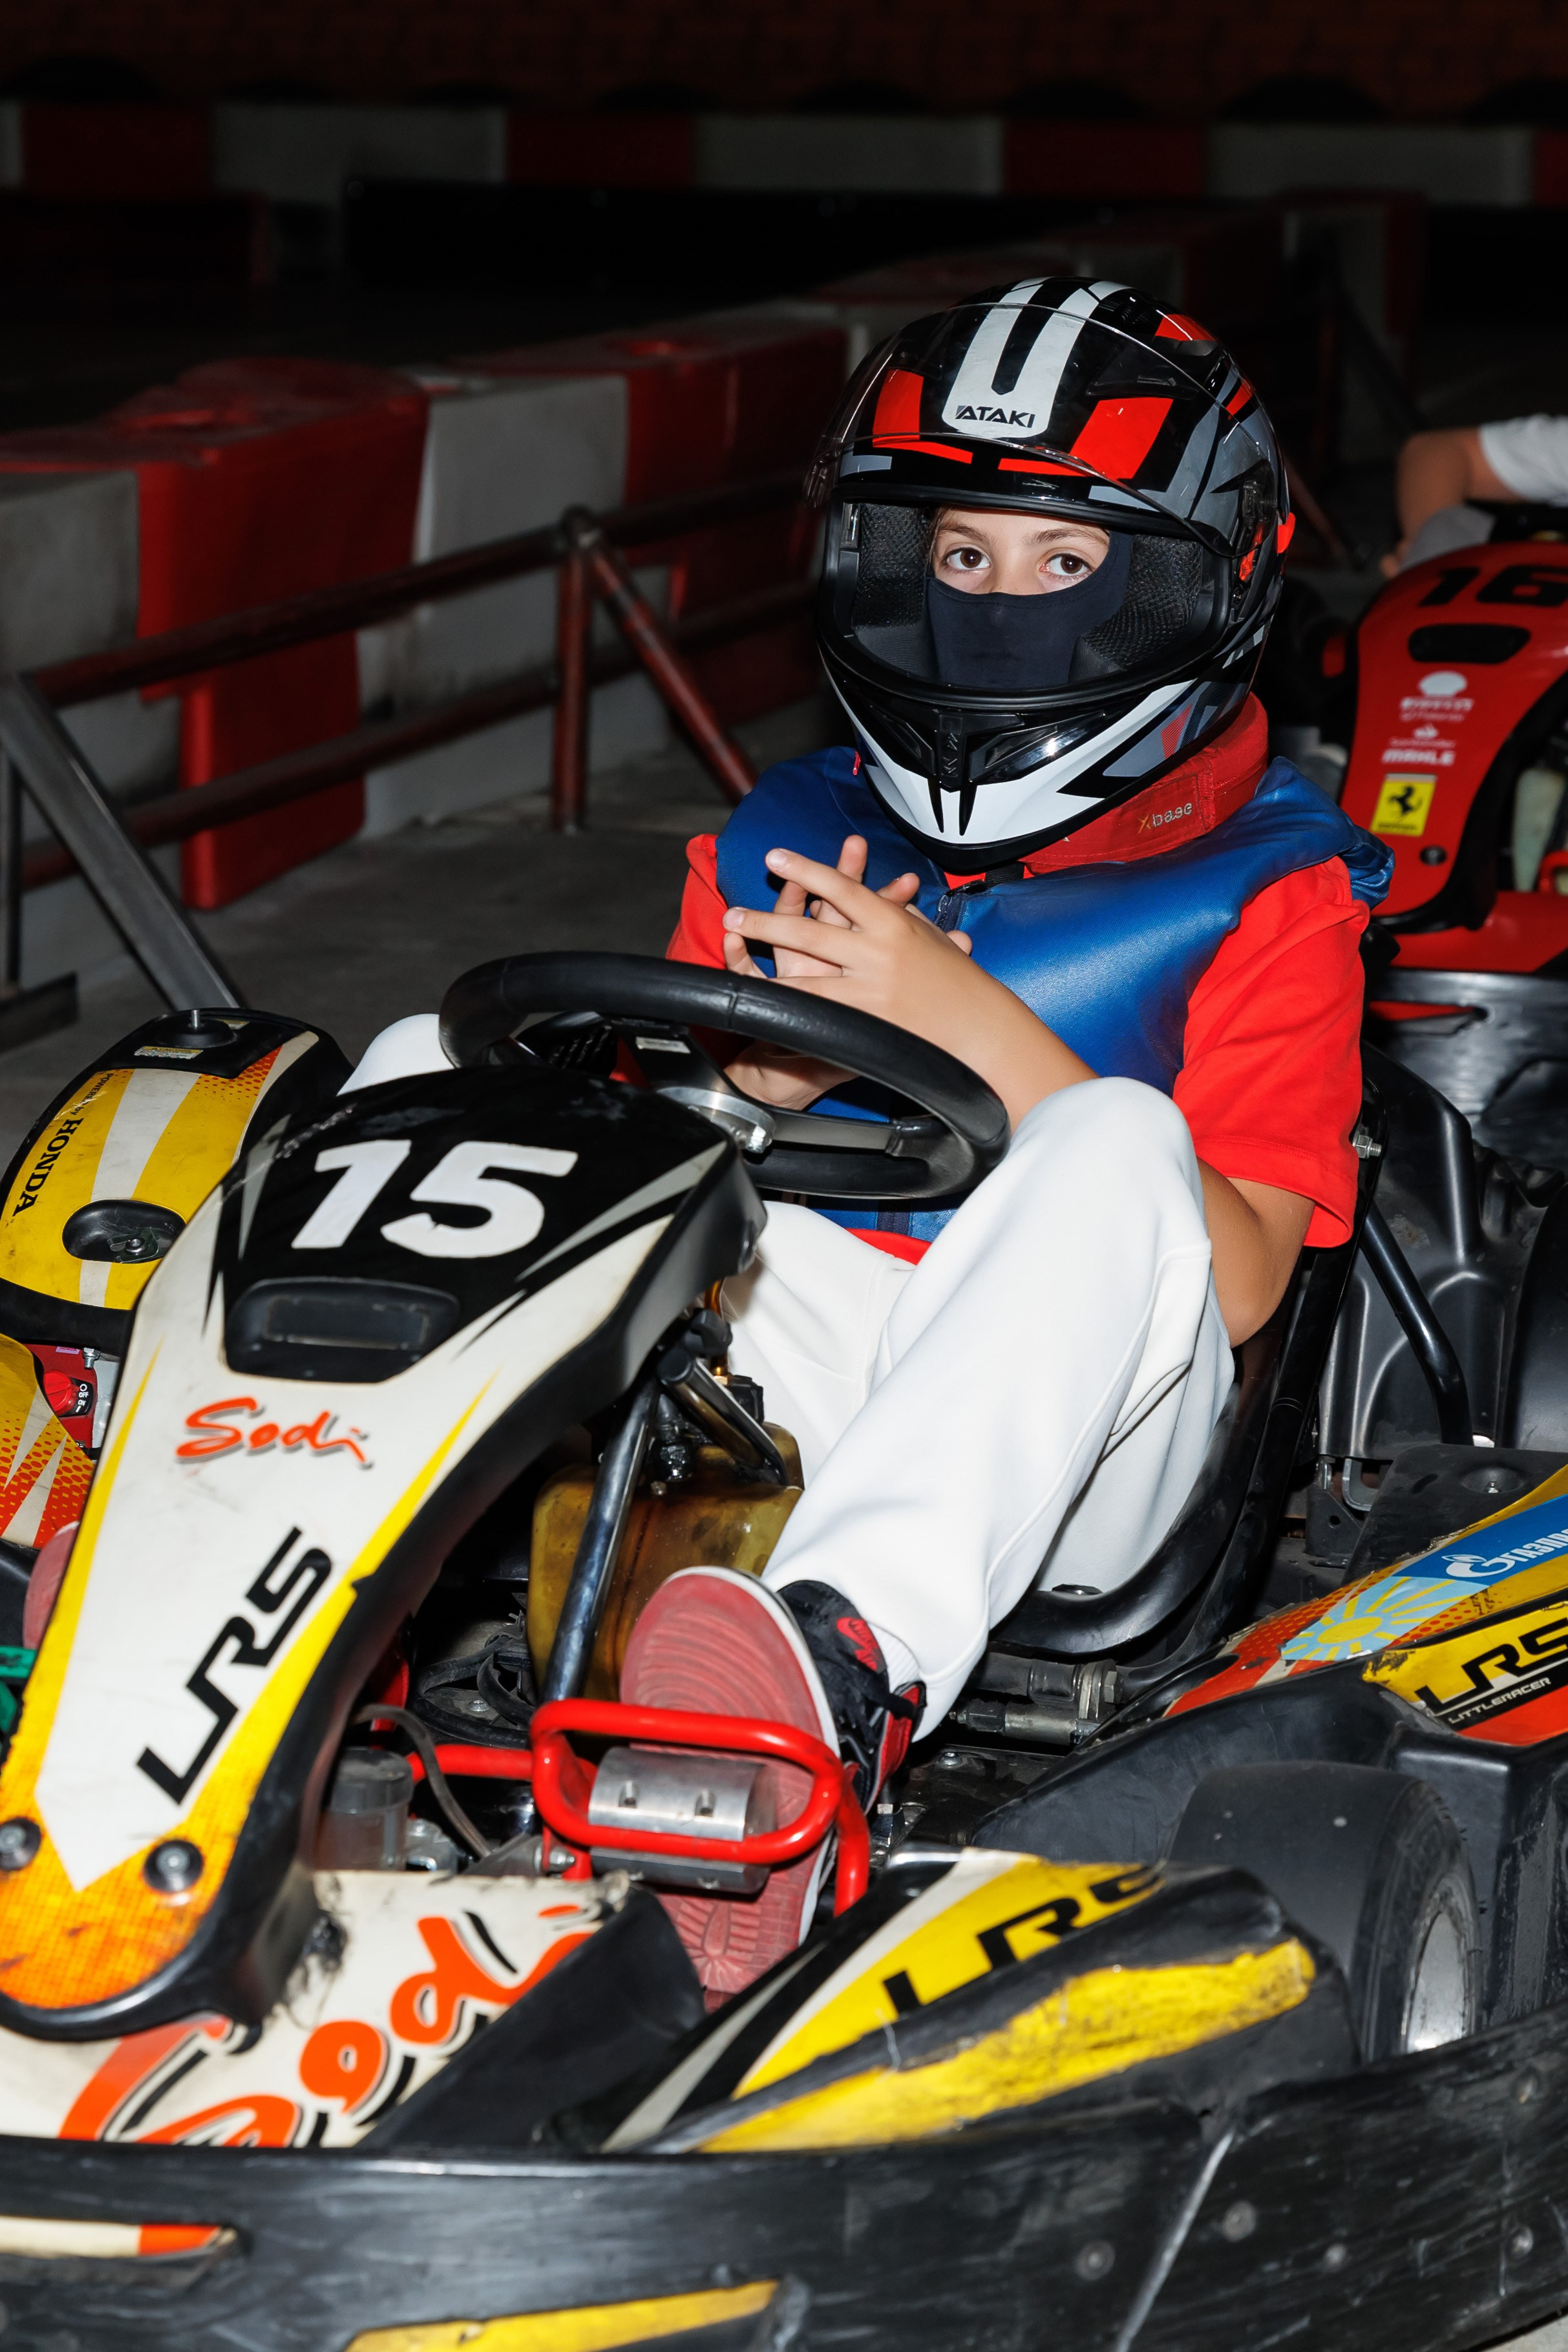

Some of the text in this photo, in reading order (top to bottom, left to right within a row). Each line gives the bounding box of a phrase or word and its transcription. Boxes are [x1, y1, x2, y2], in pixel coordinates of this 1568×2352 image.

[955, 405, 1036, 429] ATAKI
[1417, 564, 1568, 608] 16
[12, 1117, 85, 1217] HONDA
[291, 1139, 578, 1258] 15
[176, 1396, 370, 1467] Sodi
[136, 1525, 332, 1806] LRS
[1448, 1677, 1552, 1724] LITTLERACER
